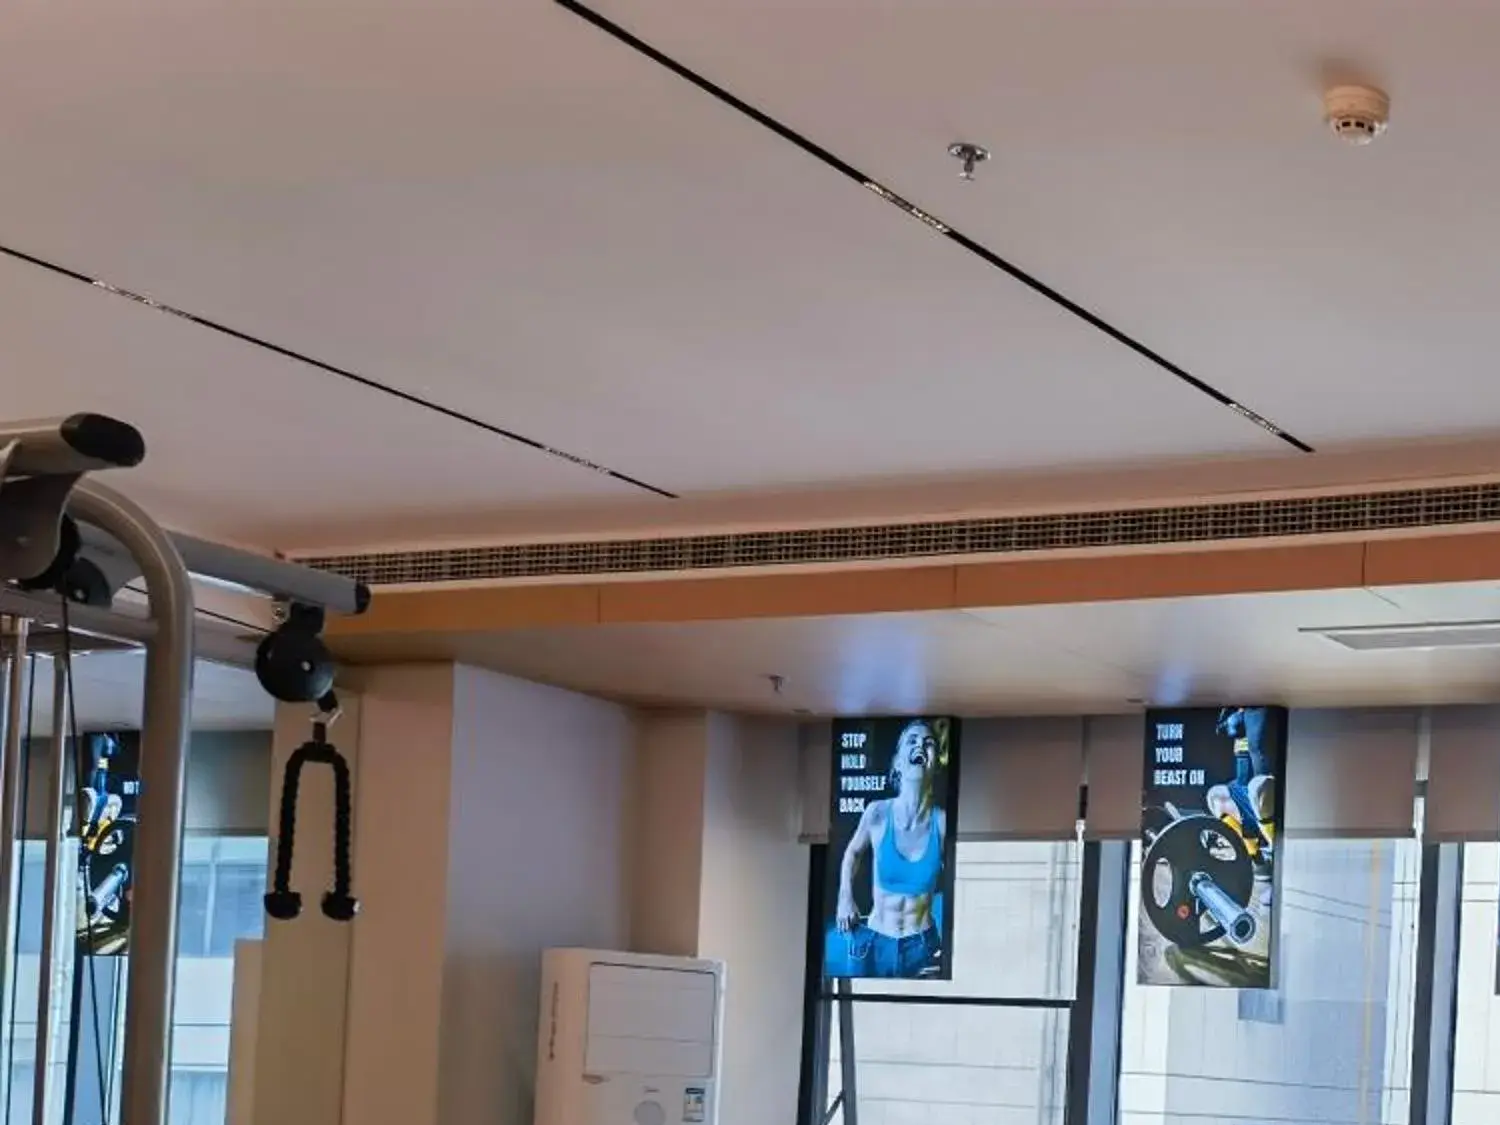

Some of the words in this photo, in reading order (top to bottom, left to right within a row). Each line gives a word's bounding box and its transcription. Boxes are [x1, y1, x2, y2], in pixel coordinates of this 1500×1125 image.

[1156, 723, 1184, 740] TURN
[841, 733, 867, 748] STOP
[1155, 747, 1183, 763] YOUR
[841, 775, 886, 791] YOURSELF
[1154, 769, 1187, 785] BEAST
[1189, 769, 1205, 785] ON
[839, 797, 865, 813] BACK
